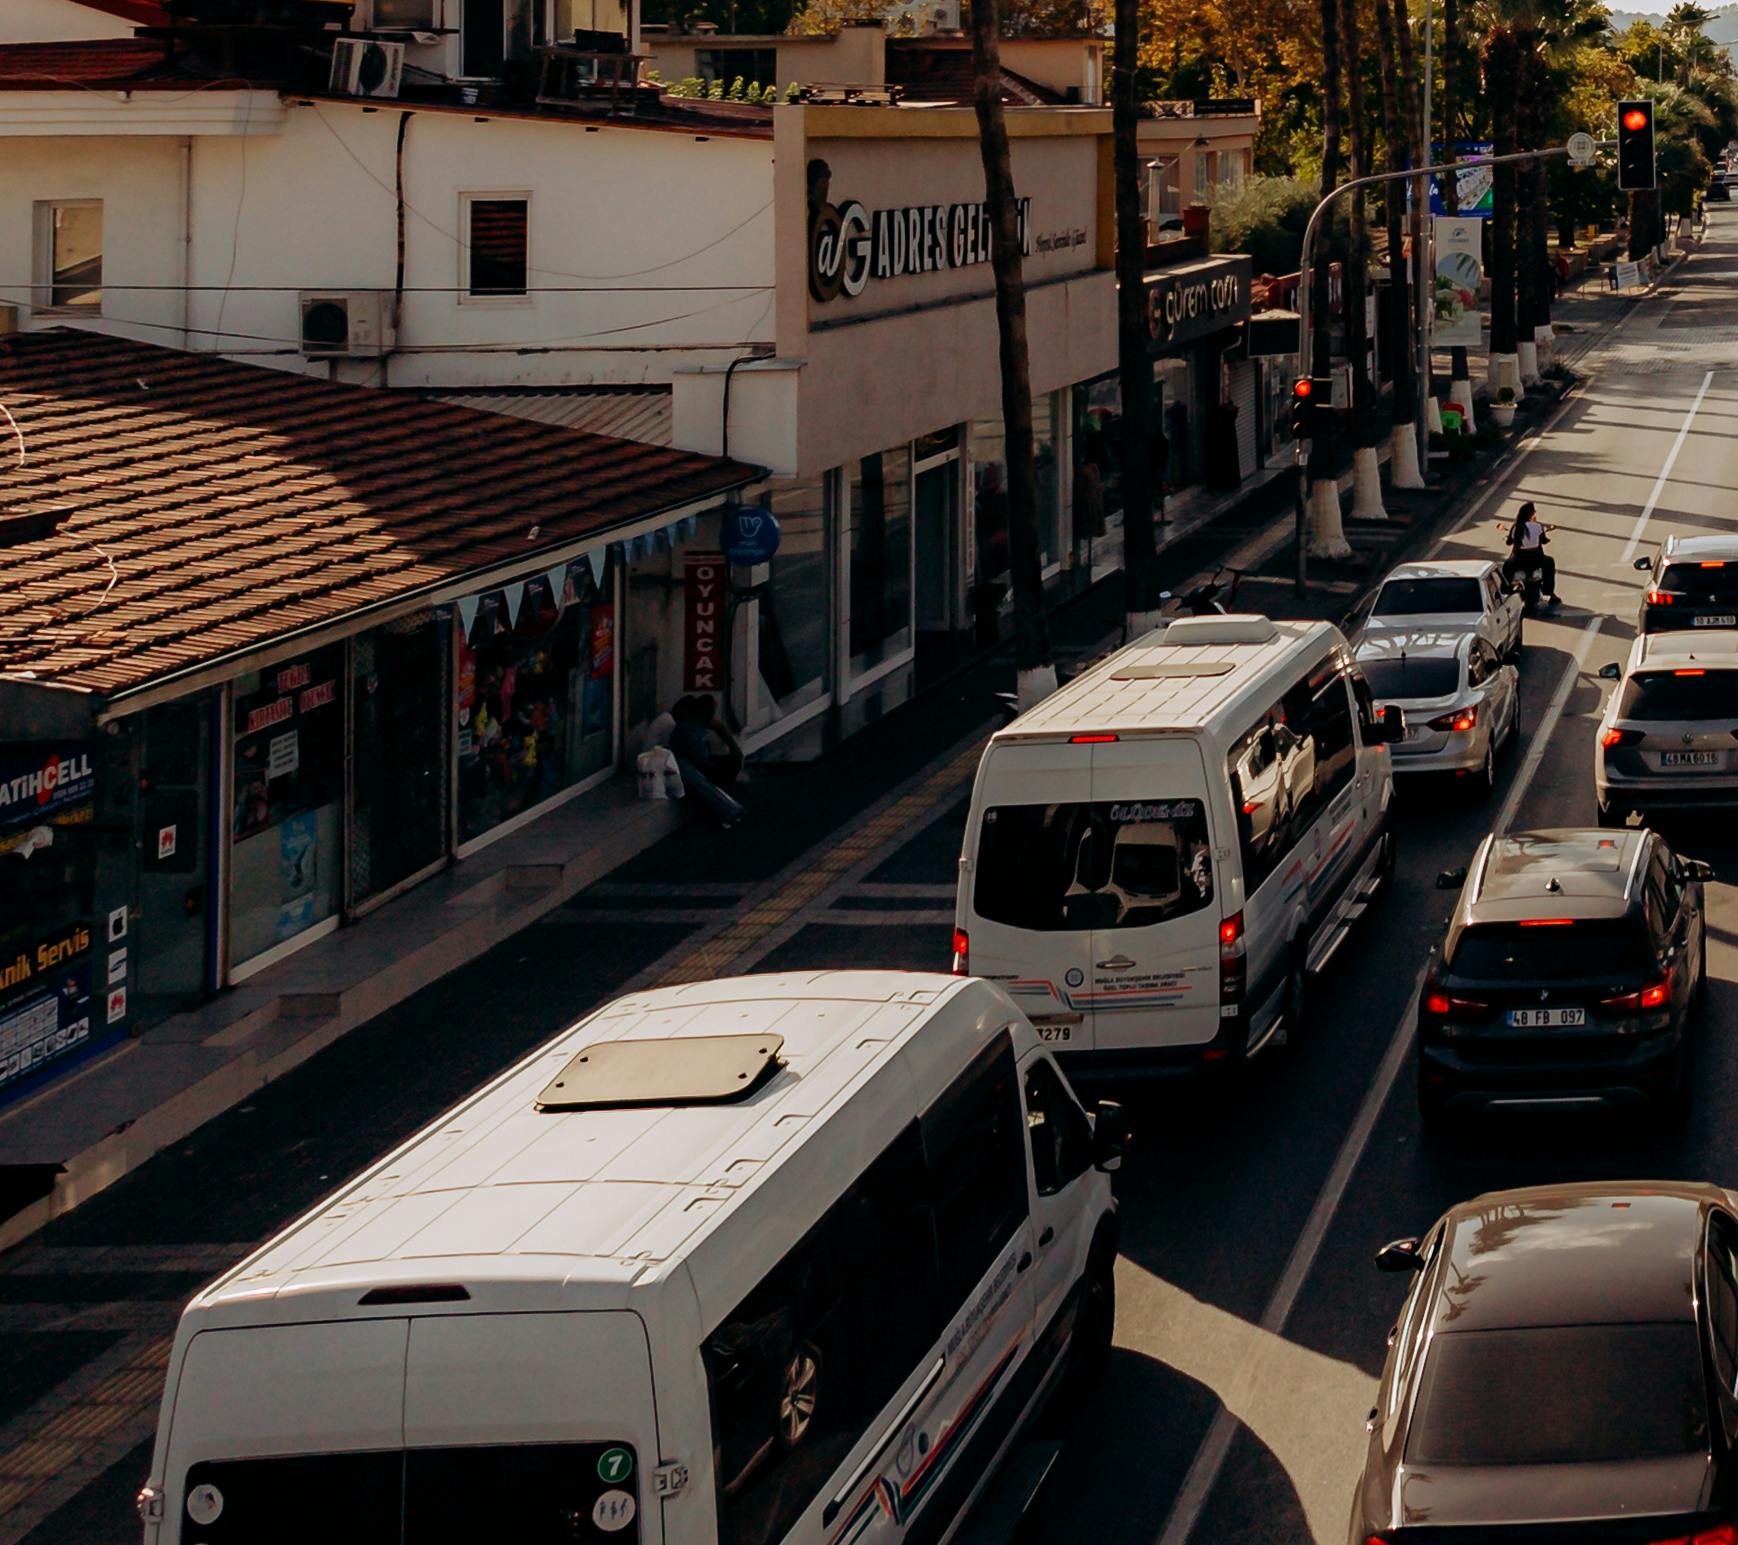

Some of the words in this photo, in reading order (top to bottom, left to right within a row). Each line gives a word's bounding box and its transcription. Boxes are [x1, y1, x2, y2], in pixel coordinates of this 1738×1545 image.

[874, 206, 947, 279] ADRES
[951, 198, 1033, 268] GELİİK
[694, 566, 716, 689] OYUNCAK
[36, 927, 91, 972] Servis
[1512, 1012, 1528, 1025] 48
[1561, 1010, 1583, 1024] 097
[607, 1454, 624, 1477] 7
